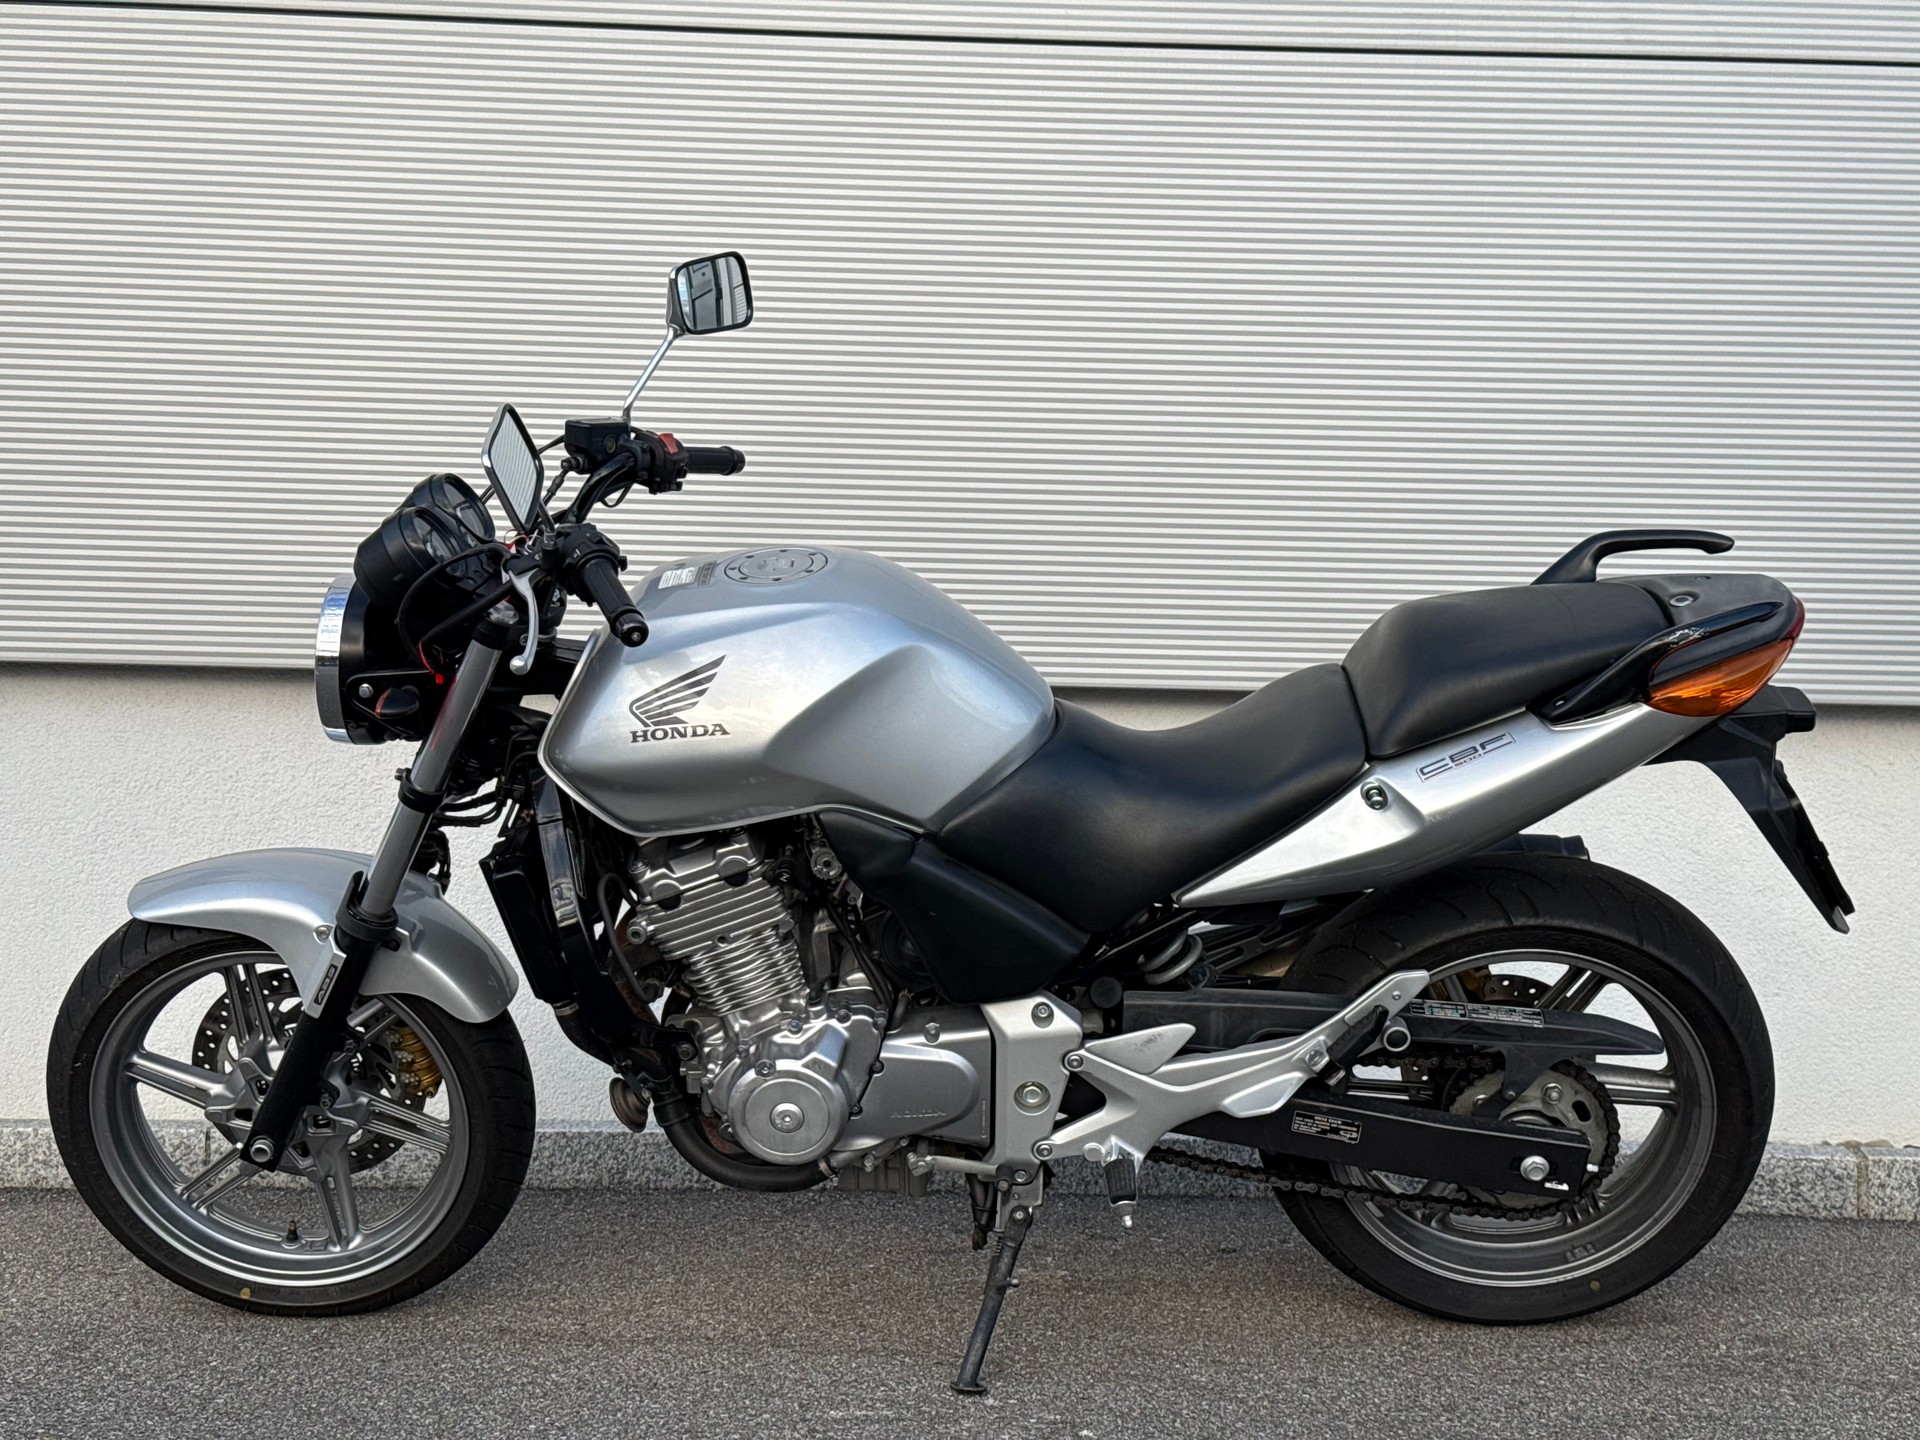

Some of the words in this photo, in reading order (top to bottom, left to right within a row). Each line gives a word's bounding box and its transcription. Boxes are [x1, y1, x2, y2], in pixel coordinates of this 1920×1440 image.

[630, 723, 730, 744] HONDA
[1419, 733, 1506, 776] CBF
[318, 966, 335, 1003] ABS
